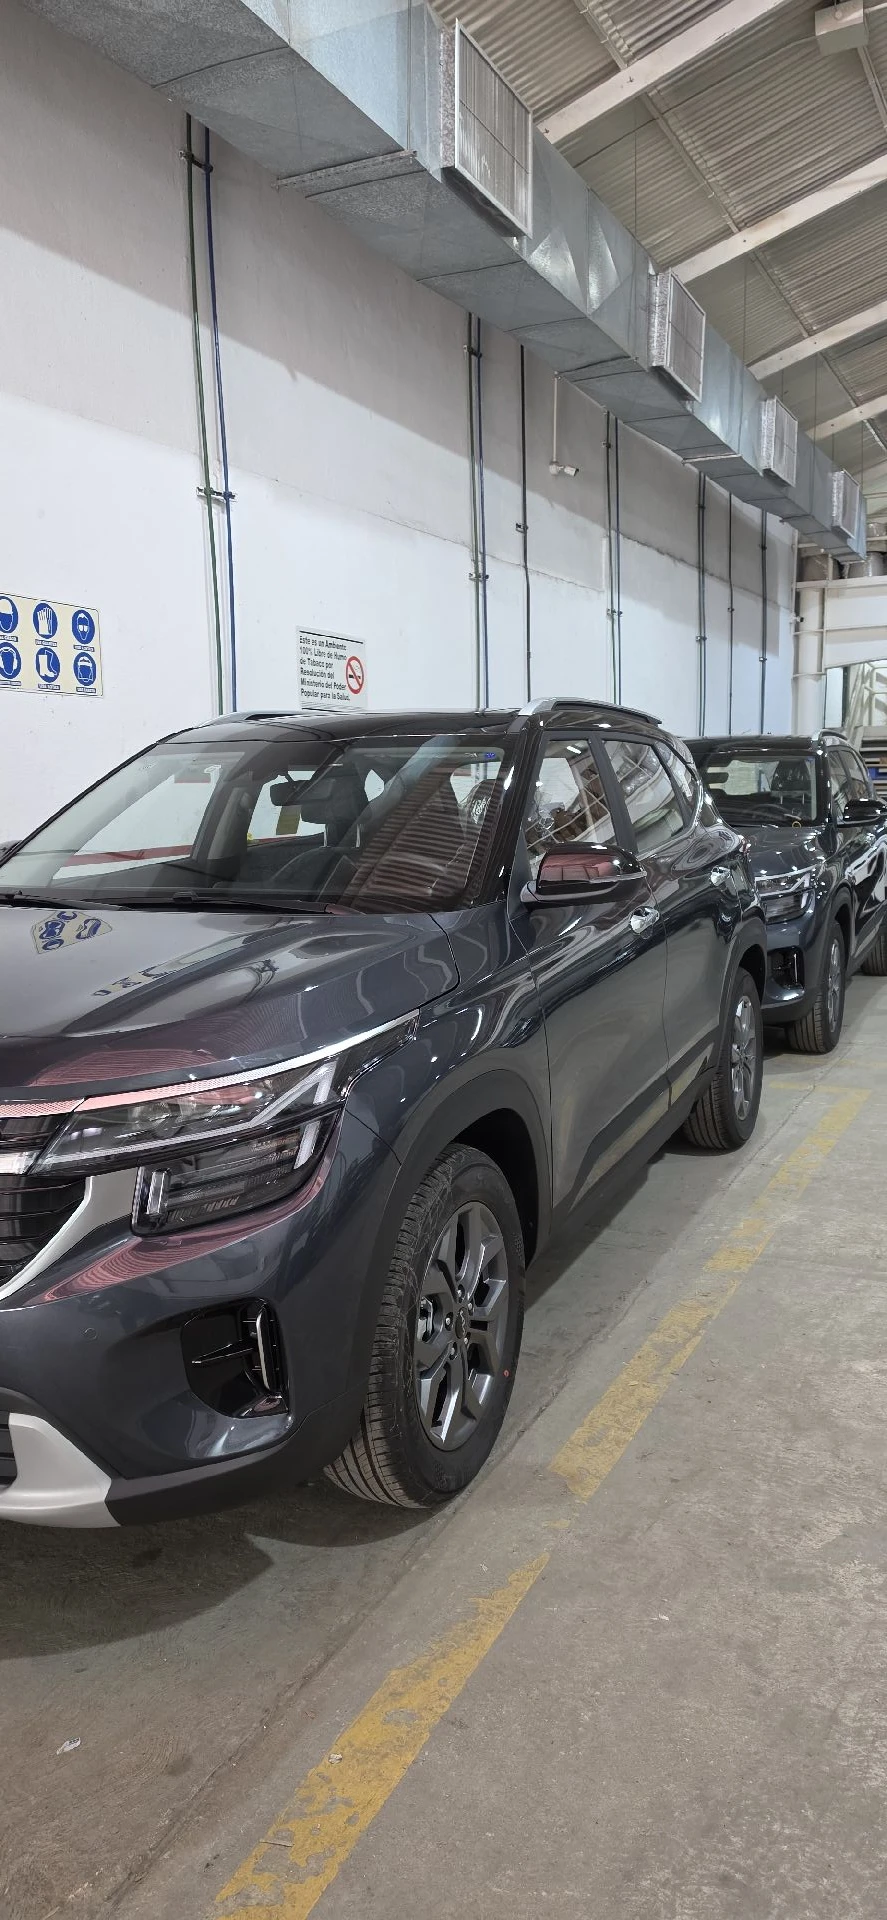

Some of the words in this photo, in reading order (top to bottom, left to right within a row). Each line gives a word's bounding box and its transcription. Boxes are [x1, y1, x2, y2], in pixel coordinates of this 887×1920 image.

[300, 636, 310, 644] Este
[300, 646, 313, 655] 100%
[327, 651, 333, 659] de
[300, 657, 306, 665] de
[307, 658, 325, 668] Tabaco
[301, 677, 324, 688] Ministerio
[333, 682, 346, 691] Poder
[301, 688, 319, 698] Popular
[320, 692, 331, 700] para
